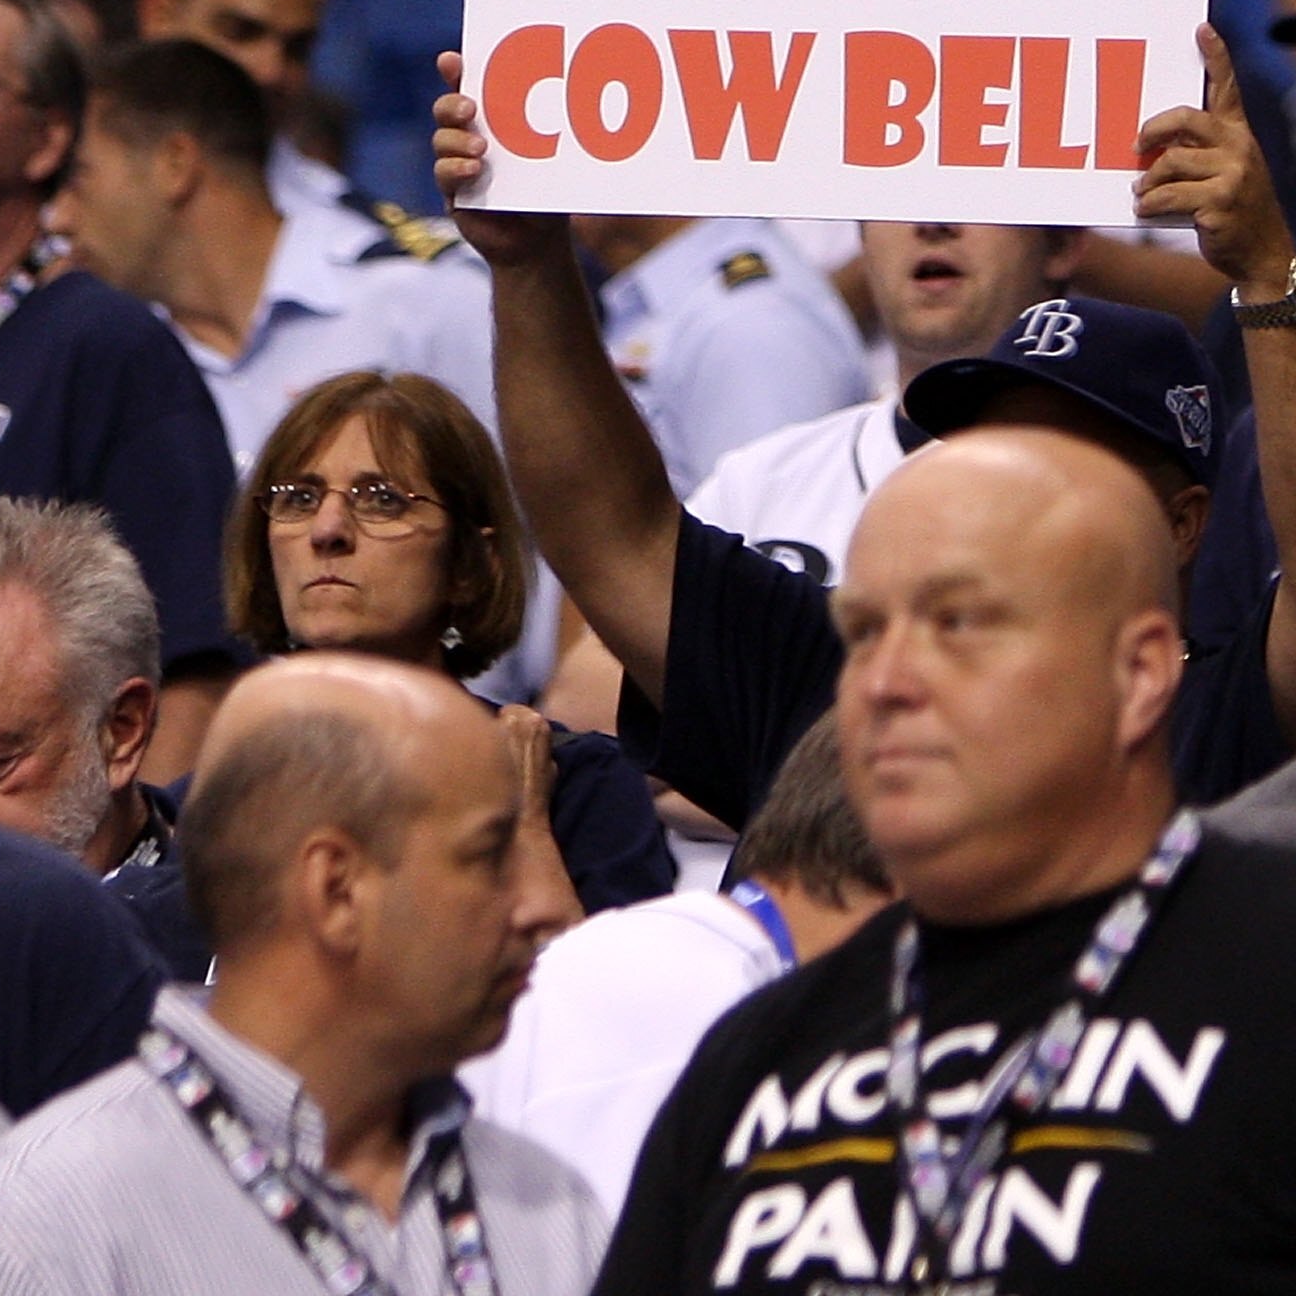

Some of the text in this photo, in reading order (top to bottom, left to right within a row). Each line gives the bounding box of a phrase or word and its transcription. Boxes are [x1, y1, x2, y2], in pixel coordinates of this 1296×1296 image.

[482, 23, 1166, 172] COW BELL
[1012, 297, 1084, 359] TB
